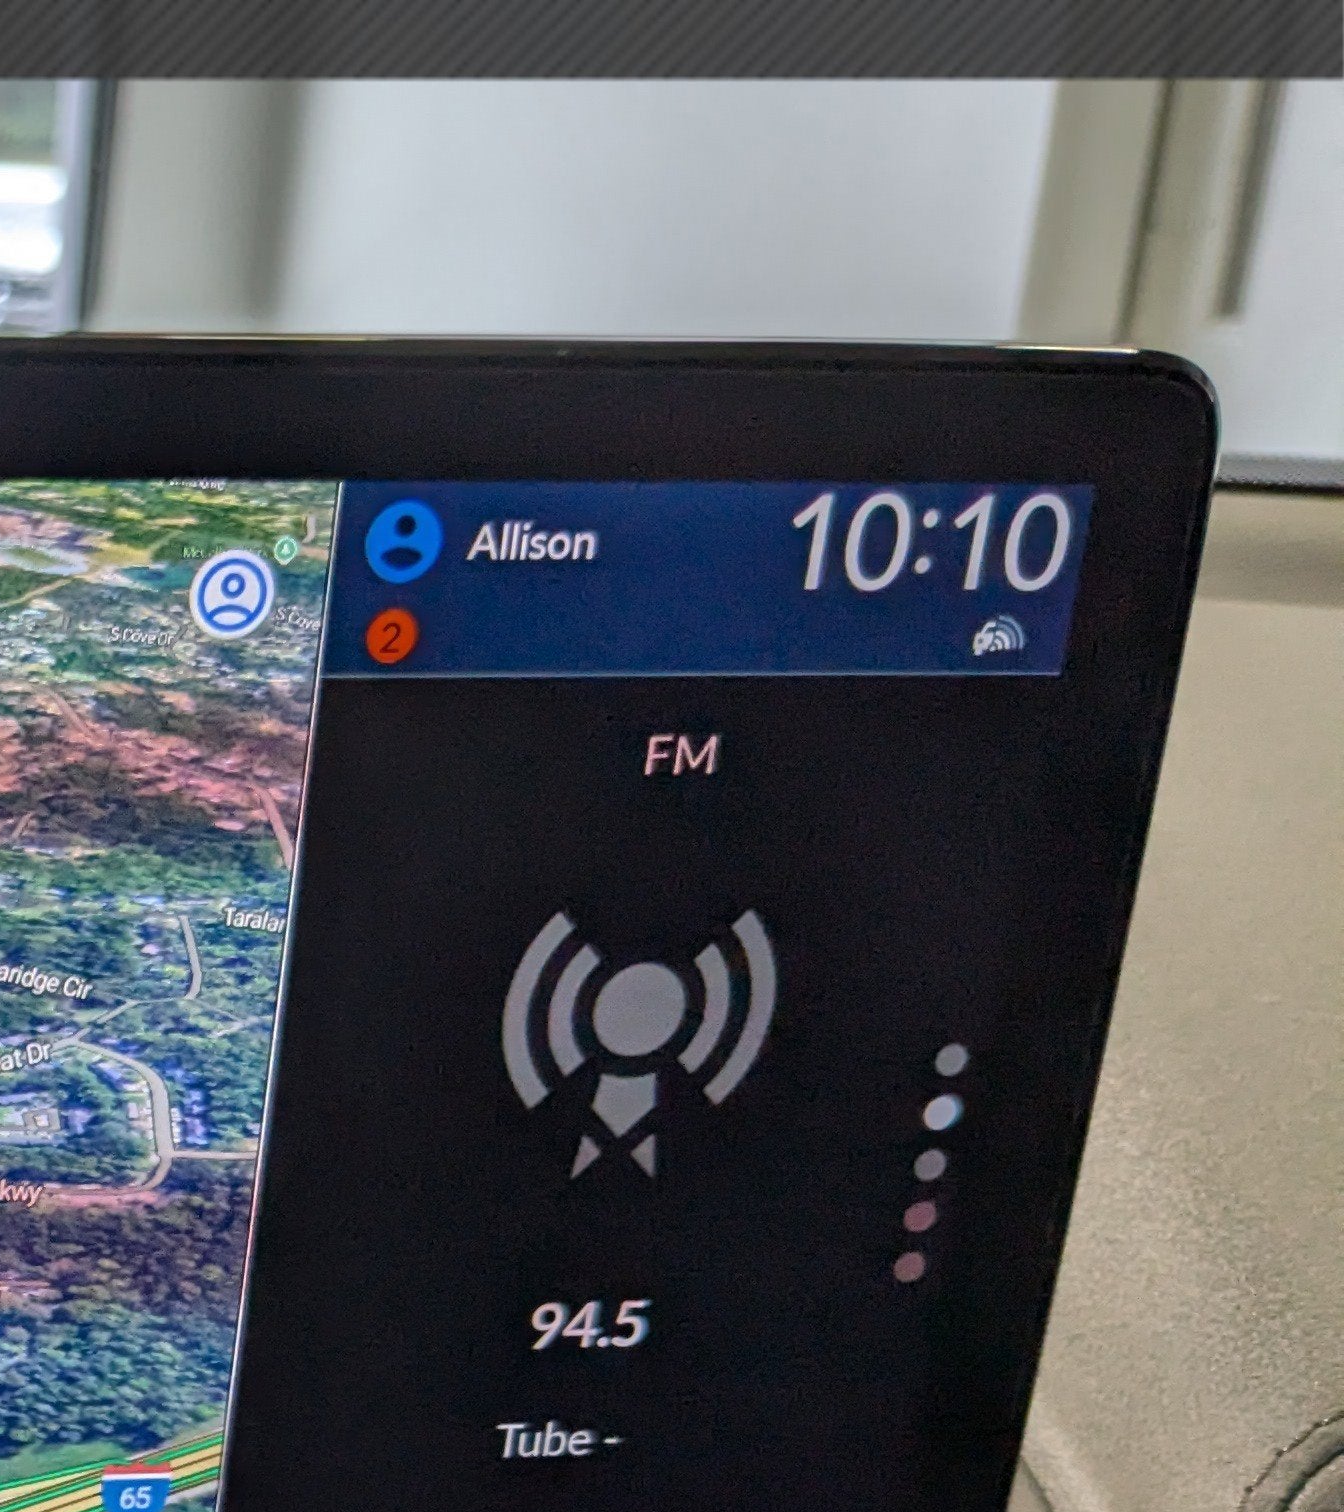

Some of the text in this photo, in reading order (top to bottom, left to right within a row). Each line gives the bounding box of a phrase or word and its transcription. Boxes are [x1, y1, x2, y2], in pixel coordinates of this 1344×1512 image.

[466, 520, 598, 561] Allison
[793, 492, 1071, 592] 10:10
[379, 622, 402, 653] 2
[643, 733, 721, 777] FM
[62, 974, 94, 1001] Cir
[26, 1040, 53, 1066] Dr
[530, 1299, 652, 1351] 94.5
[496, 1420, 599, 1459] Tube
[119, 1486, 153, 1510] 65
